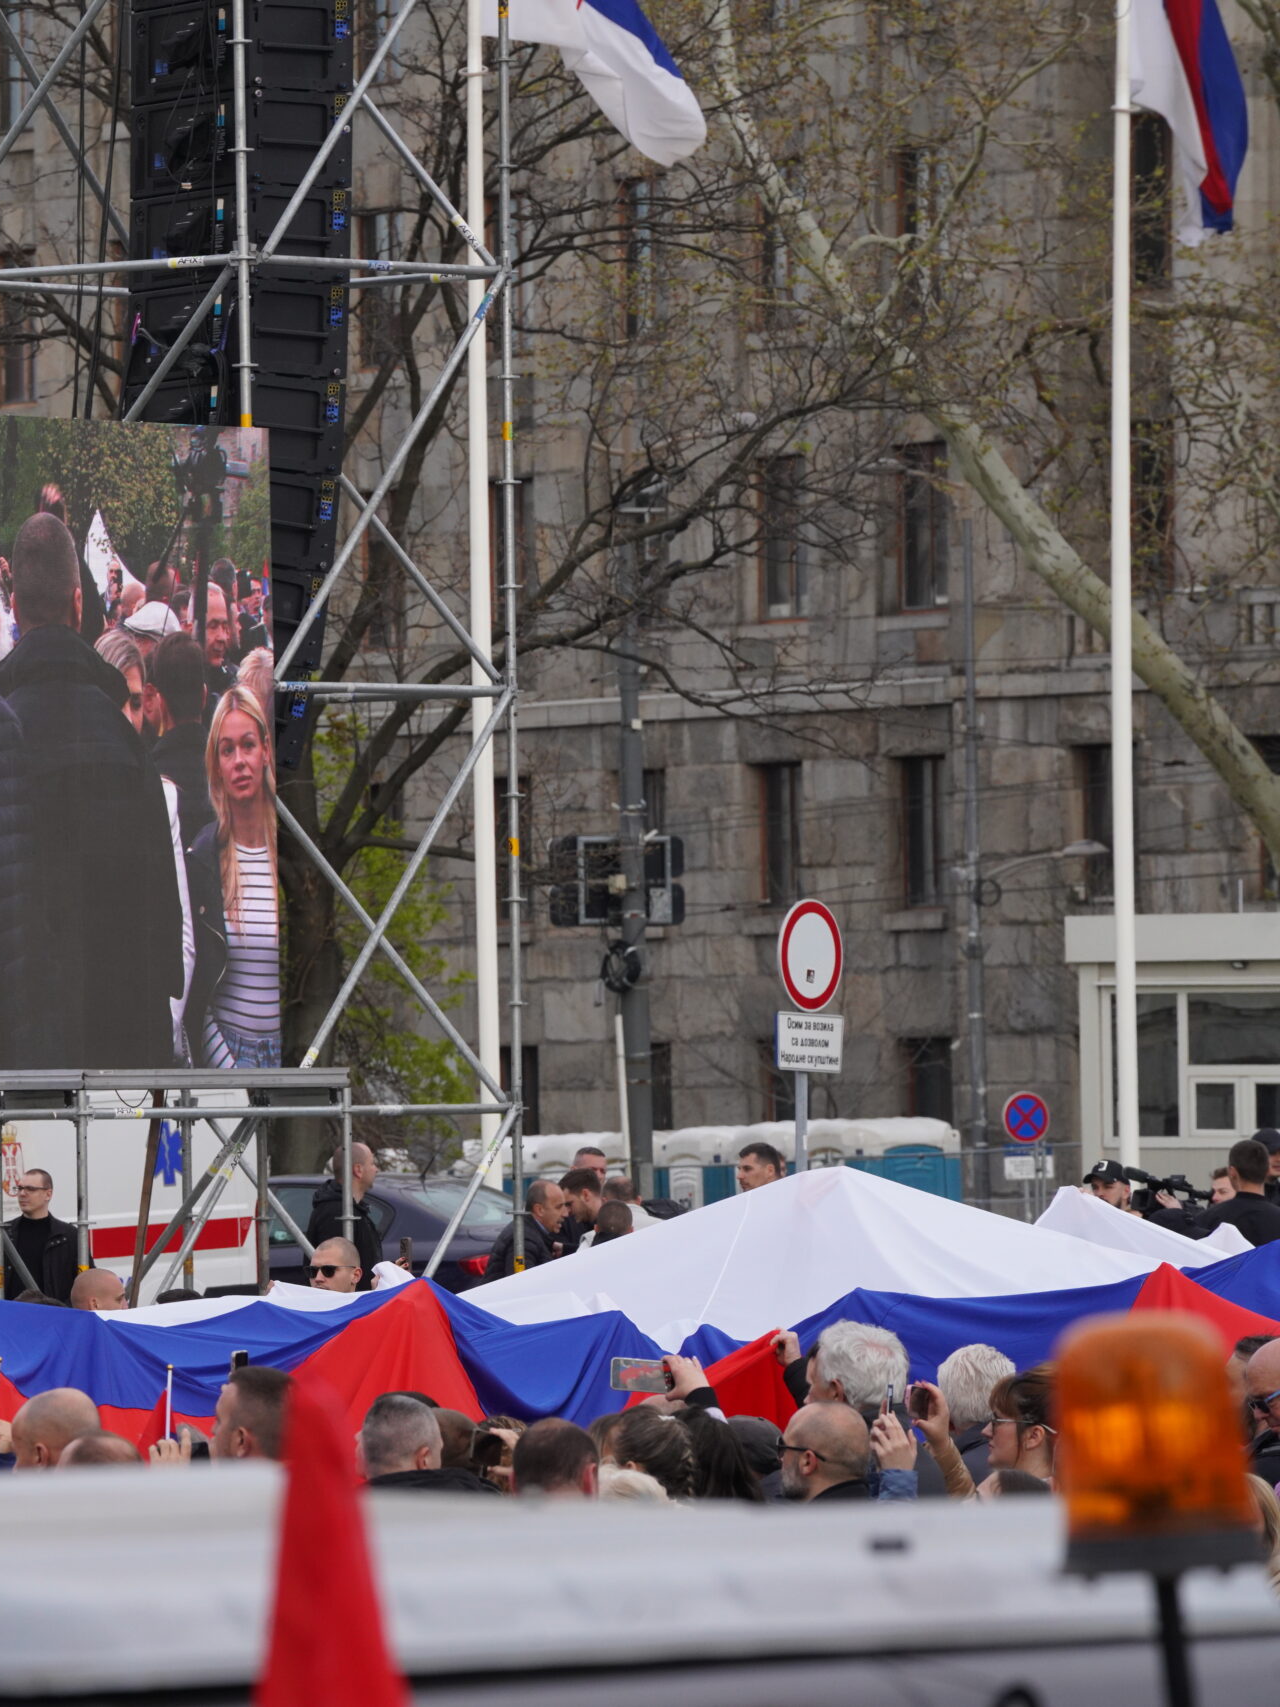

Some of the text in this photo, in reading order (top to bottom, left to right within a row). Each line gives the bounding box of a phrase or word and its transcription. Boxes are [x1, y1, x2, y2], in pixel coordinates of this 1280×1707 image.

[787, 1017, 834, 1032] Осим за возила
[791, 1036, 829, 1048] са дозволом
[781, 1050, 839, 1067] Народне скупштине
